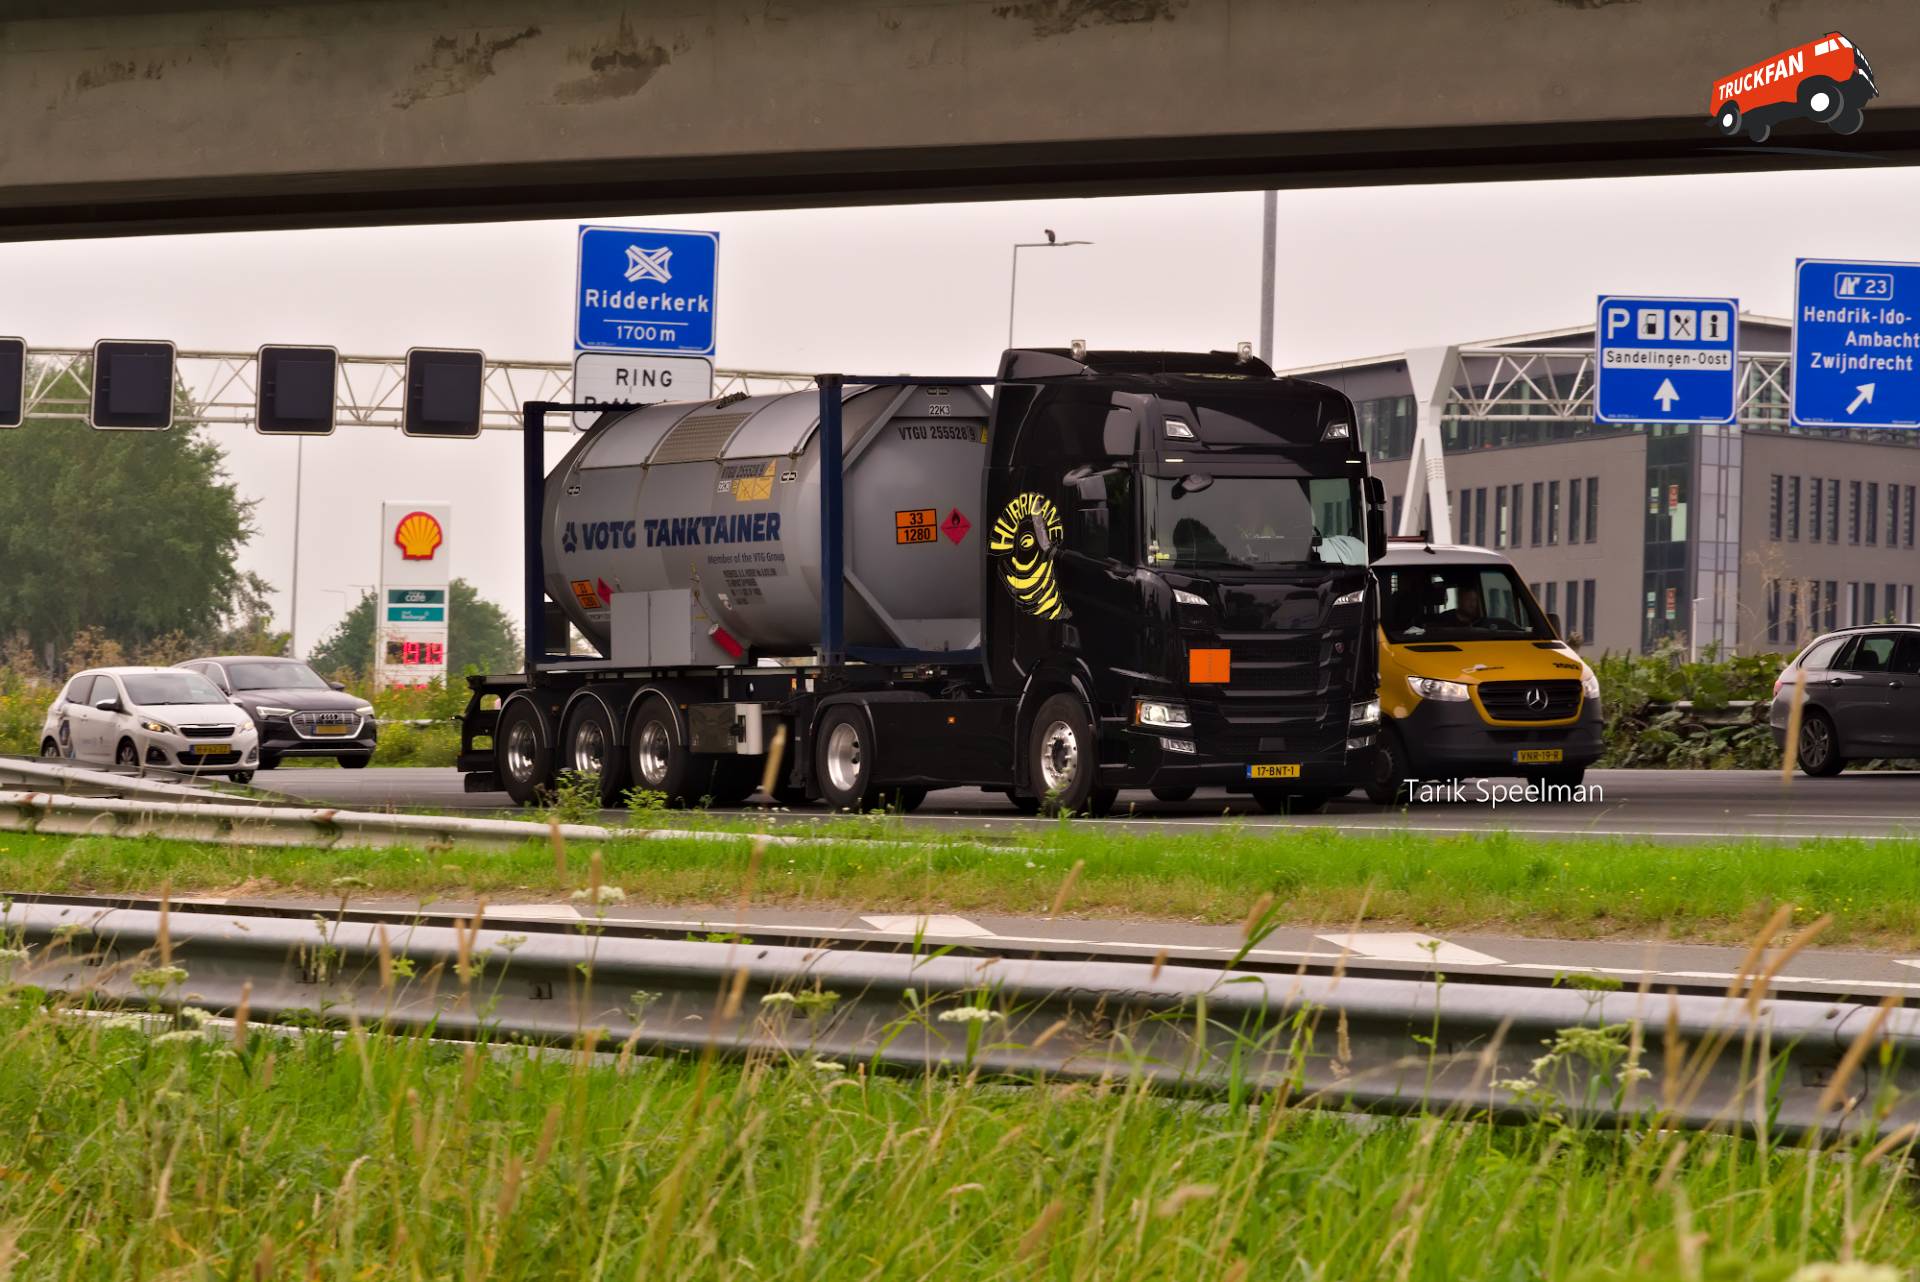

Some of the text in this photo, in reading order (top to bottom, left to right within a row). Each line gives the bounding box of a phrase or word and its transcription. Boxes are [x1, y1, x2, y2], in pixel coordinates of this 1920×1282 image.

[1865, 278, 1887, 294] 23
[585, 289, 709, 312] Ridderkerk
[1608, 308, 1630, 339] P
[1804, 306, 1912, 325] Hendrik-Ido-
[616, 325, 676, 342] 1700 m
[1845, 331, 1920, 349] Ambacht
[1606, 351, 1728, 368] Sandelingen-Oost
[1811, 352, 1913, 374] Zwijndrecht
[616, 368, 672, 388] RING
[929, 405, 950, 415] 22K3
[899, 426, 927, 440] VTGU
[930, 425, 967, 440] 255528
[909, 513, 924, 525] 33
[990, 493, 1064, 550] HURRICANE
[581, 513, 781, 550] VOTG TANKTAINER
[903, 528, 930, 541] 1280
[1257, 765, 1295, 777] 17-BNT-1
